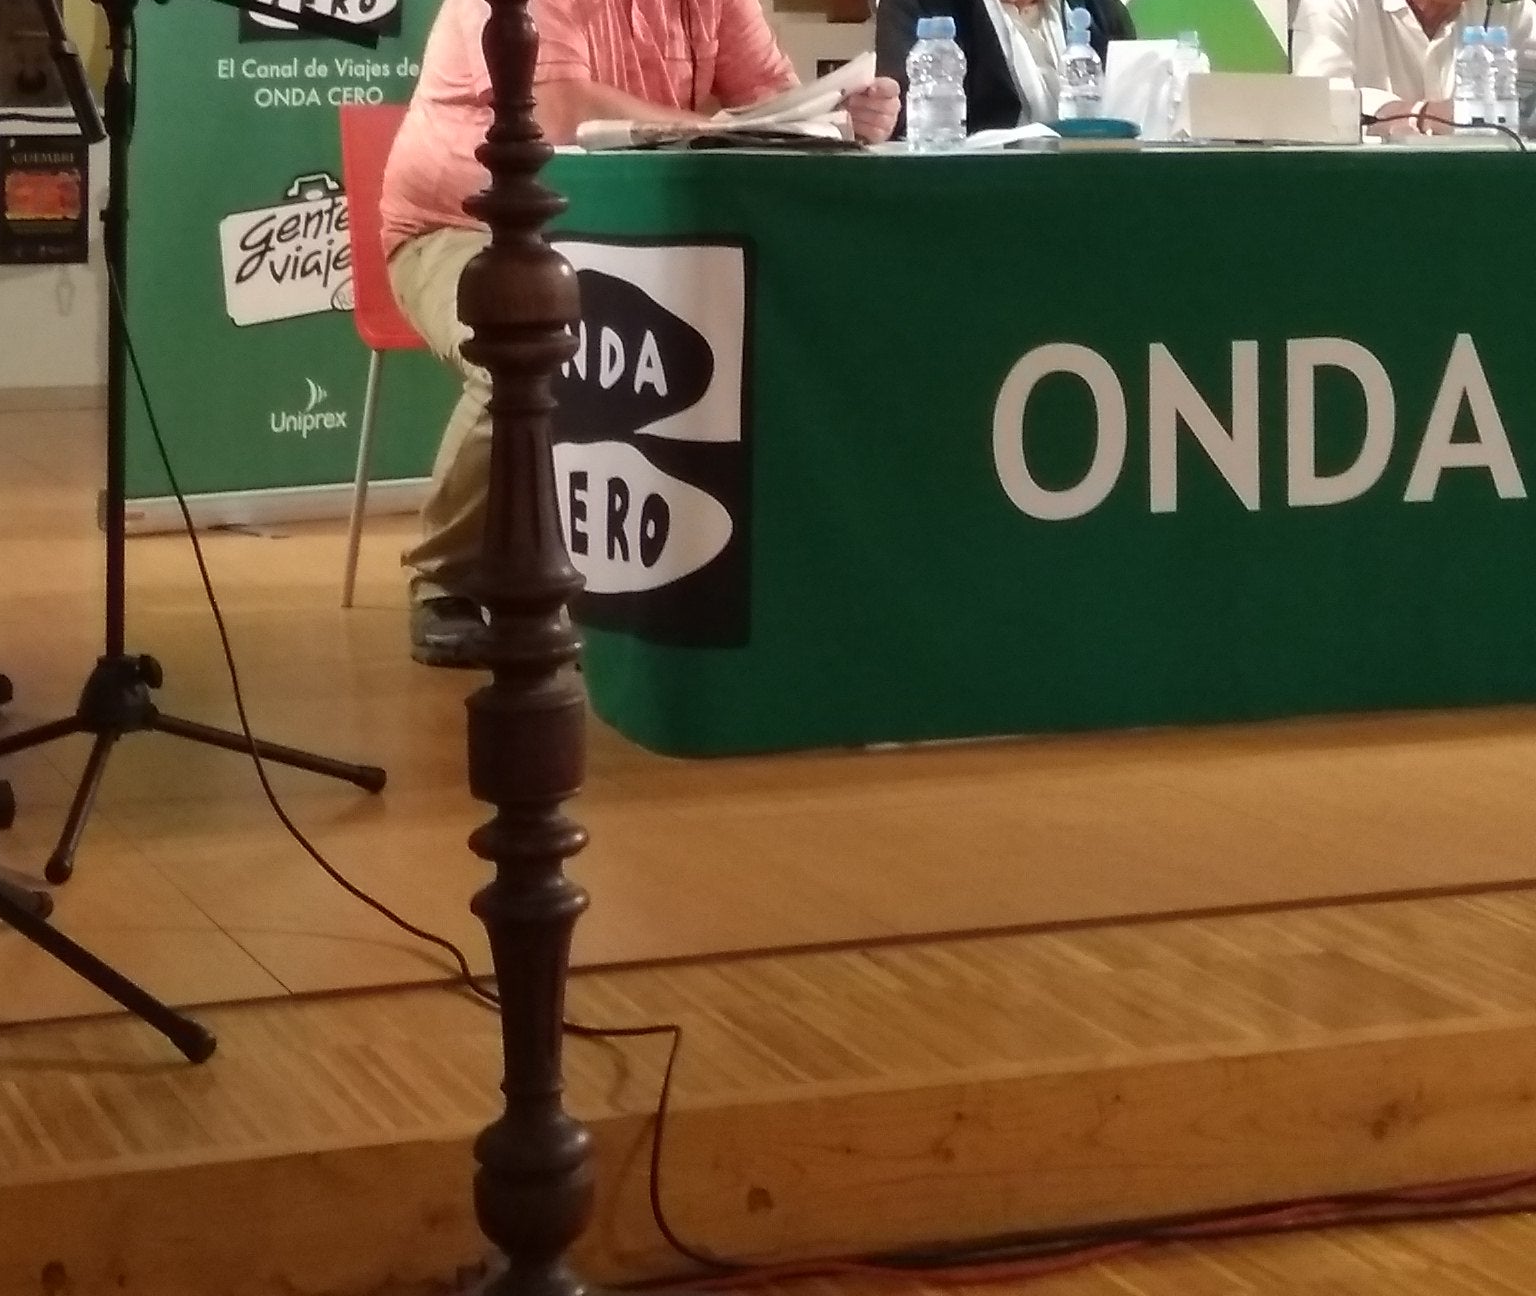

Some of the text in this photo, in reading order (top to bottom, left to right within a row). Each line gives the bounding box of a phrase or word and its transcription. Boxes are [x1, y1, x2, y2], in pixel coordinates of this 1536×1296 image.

[218, 56, 419, 81] El Canal de Viajes de
[254, 86, 383, 108] ONDA CERO
[270, 239, 352, 288] viaje
[562, 320, 668, 397] NDA
[270, 409, 348, 438] Uniprex
[991, 331, 1527, 521] ONDA
[569, 470, 670, 569] ERO
